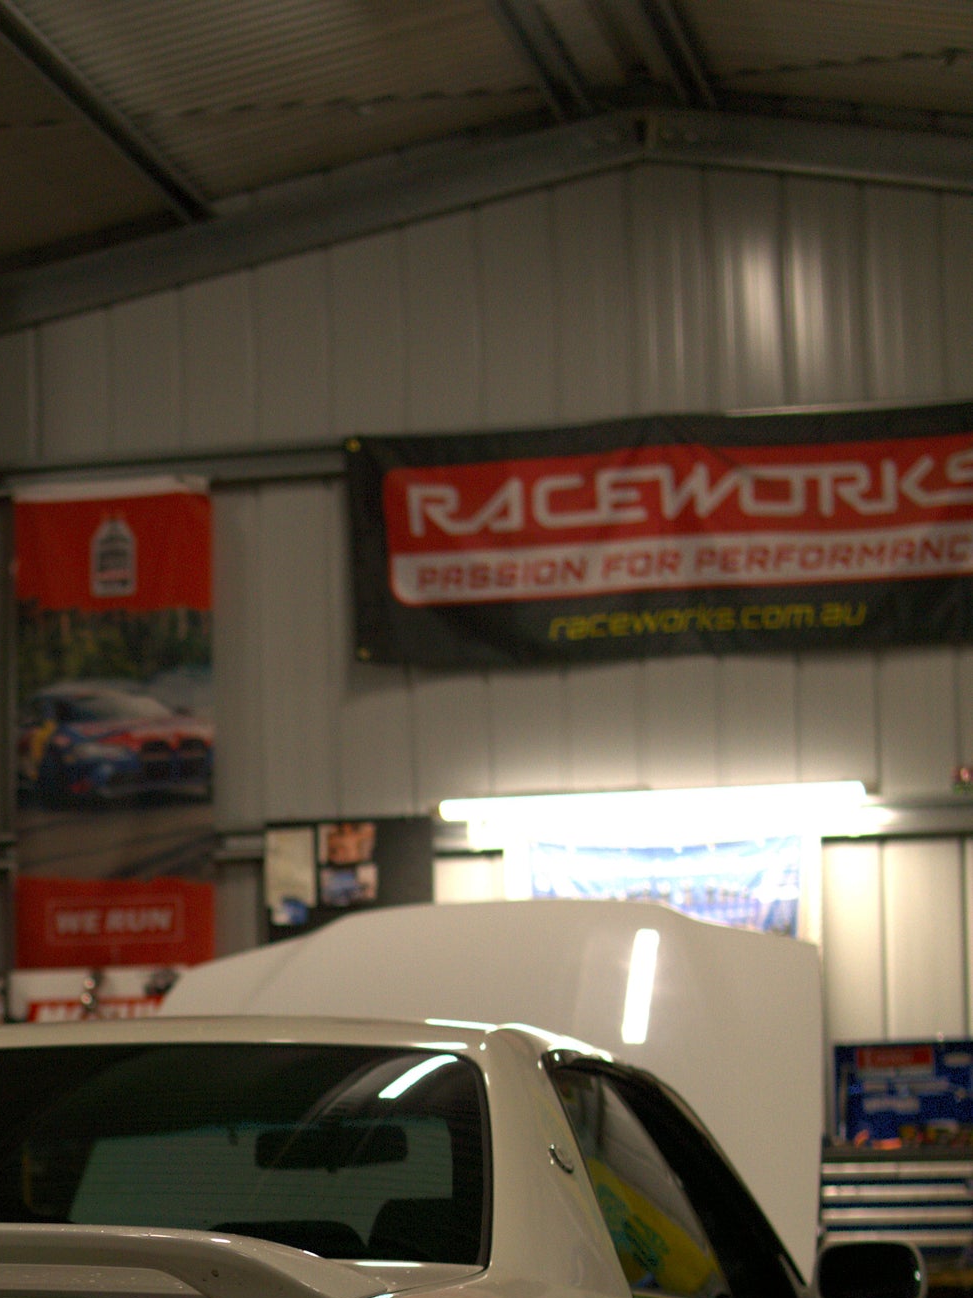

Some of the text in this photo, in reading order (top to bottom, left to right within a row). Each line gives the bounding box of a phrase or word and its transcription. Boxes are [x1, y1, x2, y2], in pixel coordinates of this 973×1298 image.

[416, 557, 588, 592] PASSION
[602, 551, 682, 580] FOR
[548, 602, 868, 642] raceworks.com.au
[54, 906, 174, 935] WE RUN
